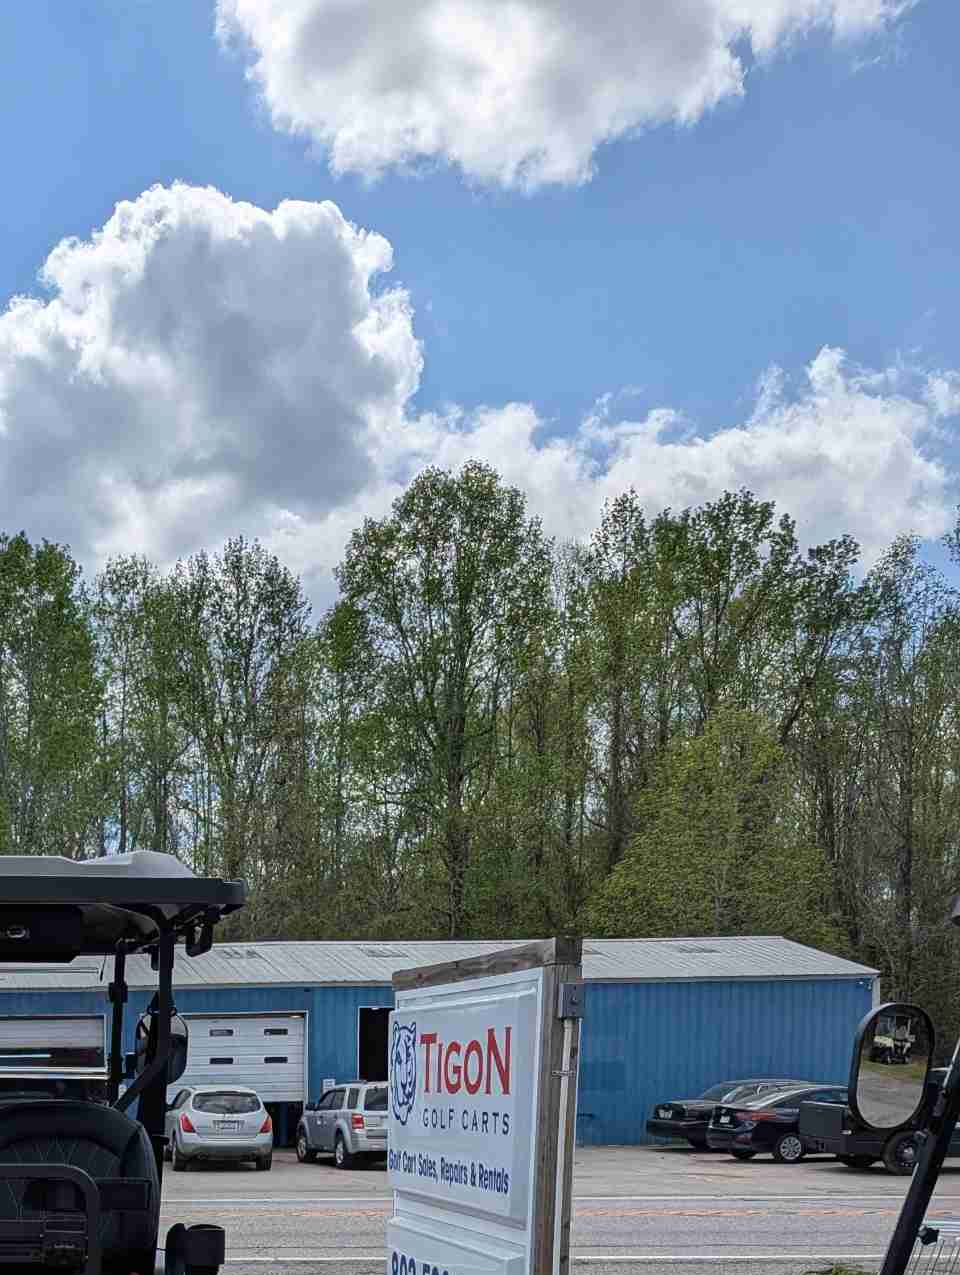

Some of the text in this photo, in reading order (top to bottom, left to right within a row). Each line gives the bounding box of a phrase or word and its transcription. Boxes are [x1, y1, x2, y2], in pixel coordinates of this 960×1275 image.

[422, 1108, 510, 1135] GOLF CARTS
[402, 1150, 417, 1174] Cart
[418, 1152, 438, 1182] Sales,
[440, 1156, 468, 1187] Repairs
[470, 1162, 477, 1187] &
[478, 1163, 509, 1194] Rentals
